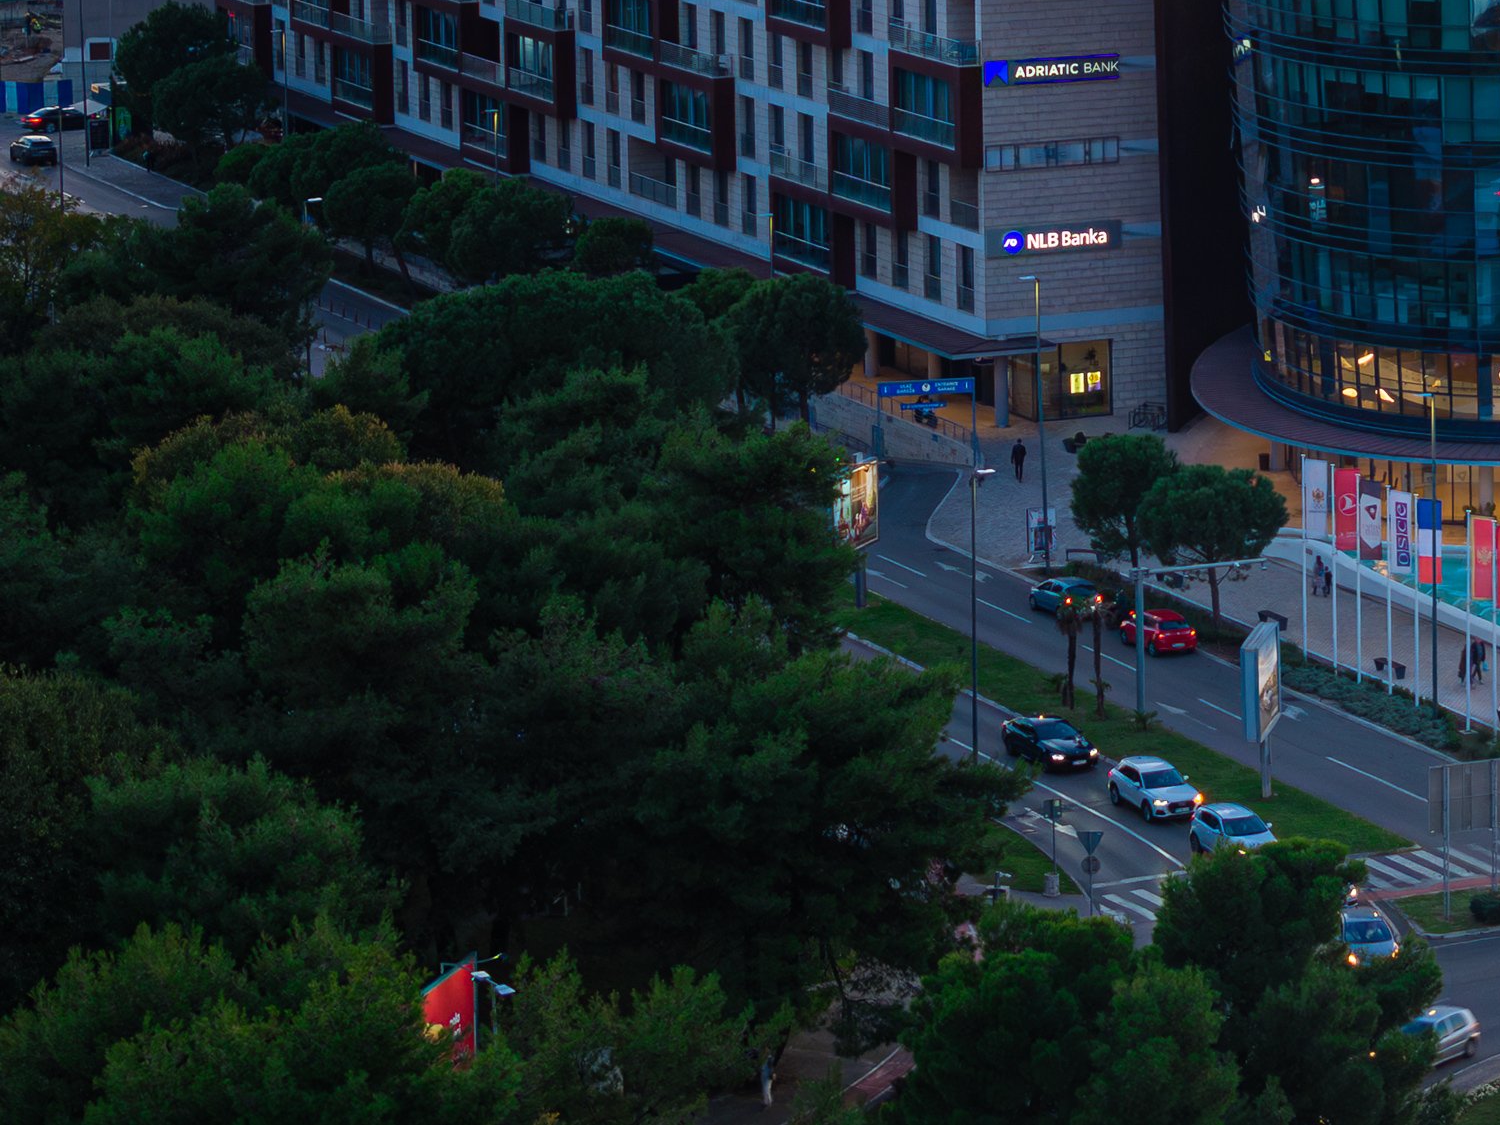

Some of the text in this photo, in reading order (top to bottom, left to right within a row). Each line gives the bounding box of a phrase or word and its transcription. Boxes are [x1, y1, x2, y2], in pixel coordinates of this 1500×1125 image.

[1015, 59, 1120, 80] ADRIATIC BANK
[1026, 228, 1108, 250] NLB Banka
